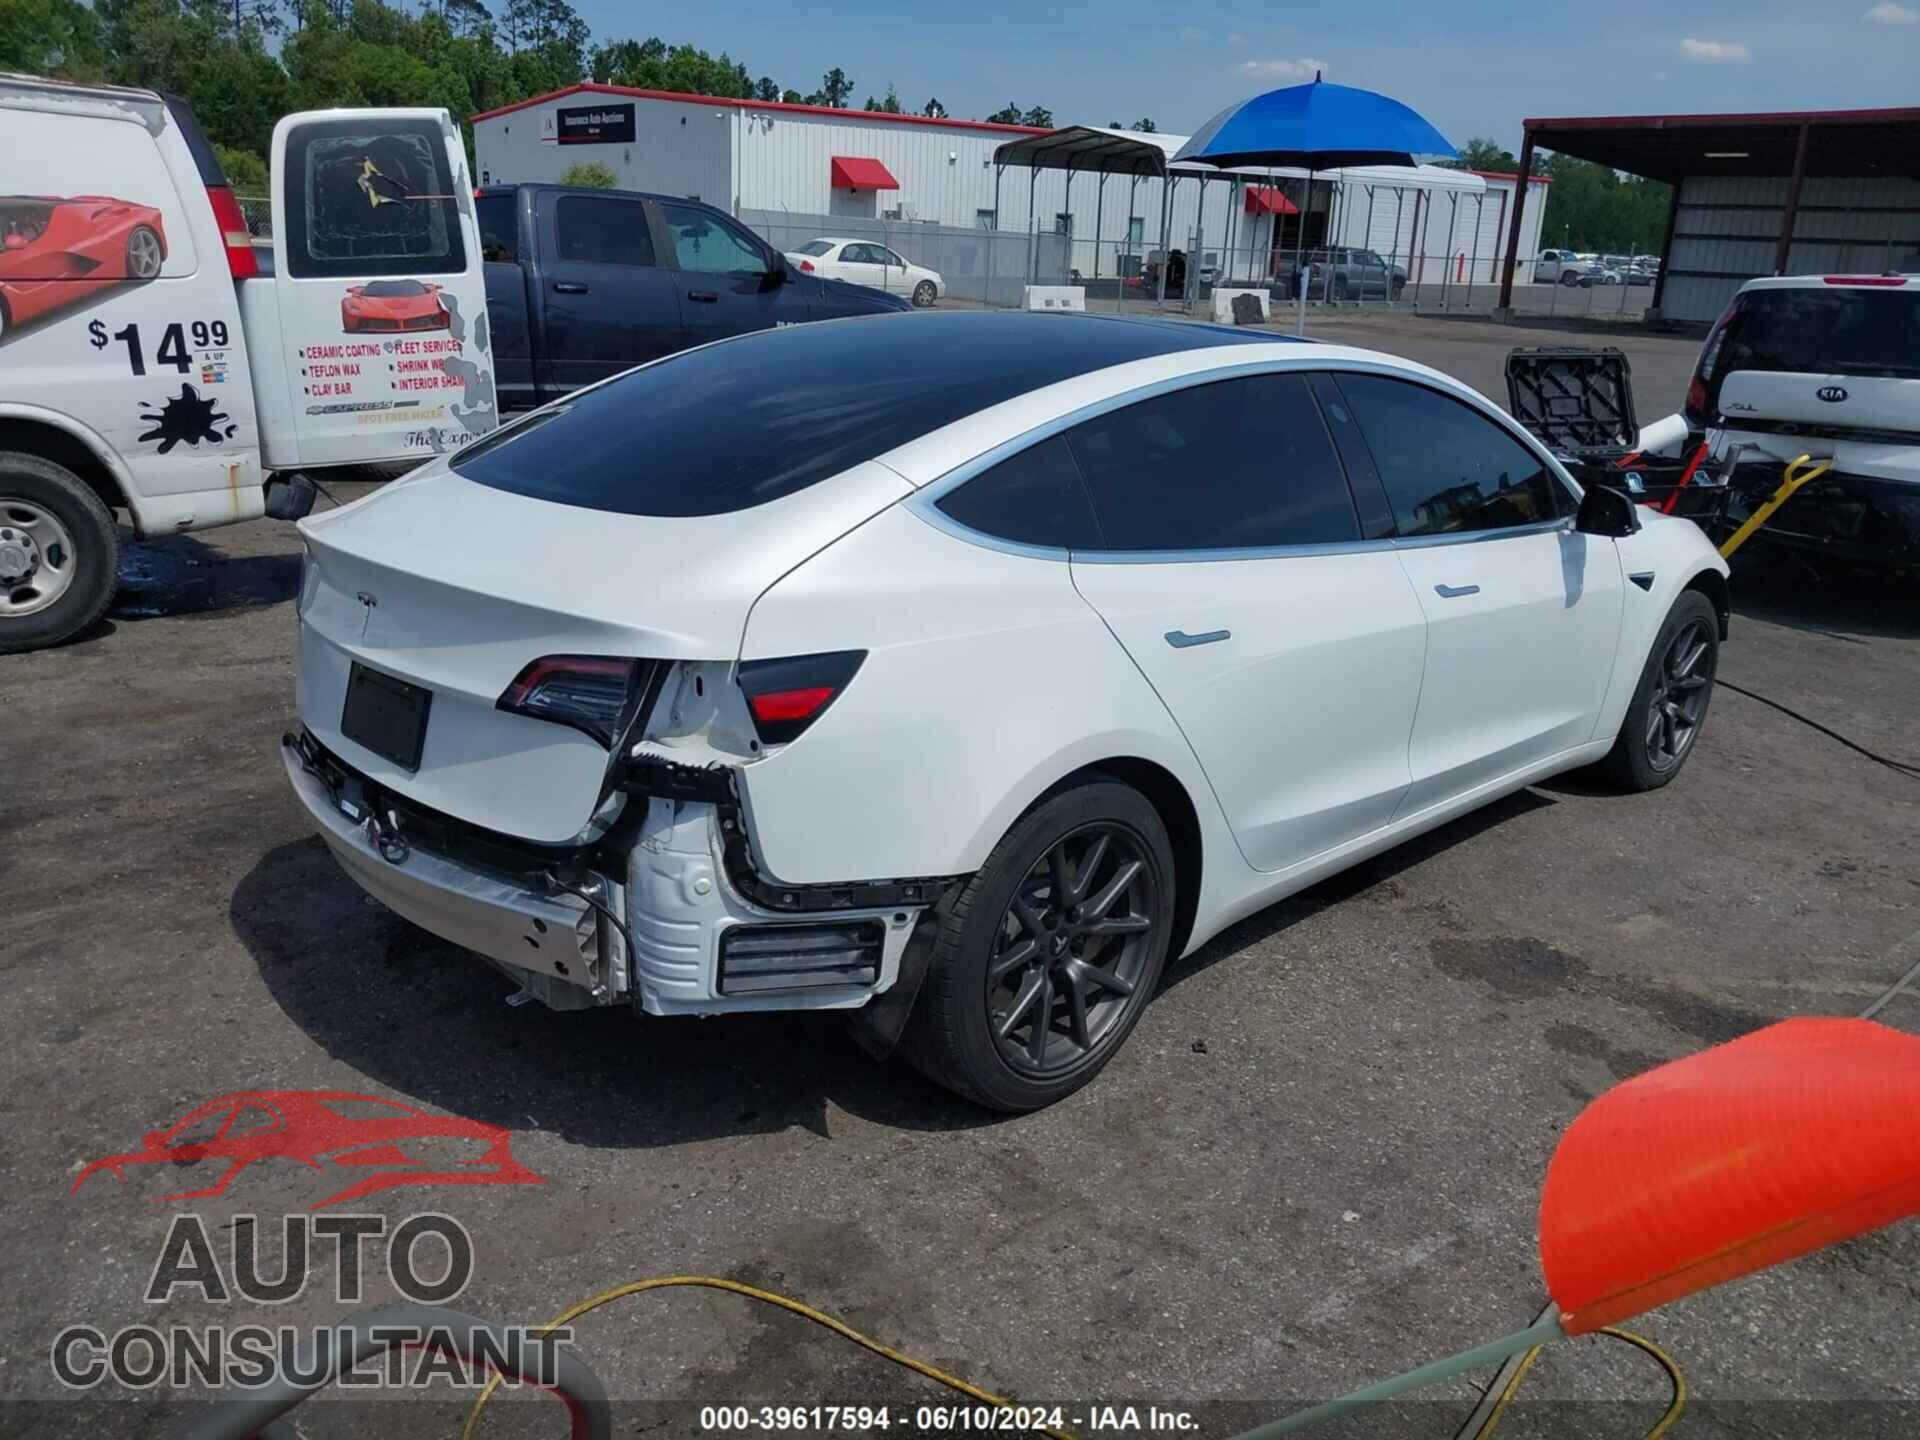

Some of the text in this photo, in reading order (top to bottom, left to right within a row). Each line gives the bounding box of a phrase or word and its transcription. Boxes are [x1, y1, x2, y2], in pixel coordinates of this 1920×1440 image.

[306, 344, 381, 359] CERAMIC COATING
[395, 342, 420, 354] FLEET
[309, 363, 361, 378] TEFLON WAX
[397, 360, 430, 372] SHRINK
[311, 382, 352, 396] CLAY BAR
[400, 377, 440, 391] INTERIOR
[1820, 388, 1844, 400] KIA
[402, 431, 433, 448] The
